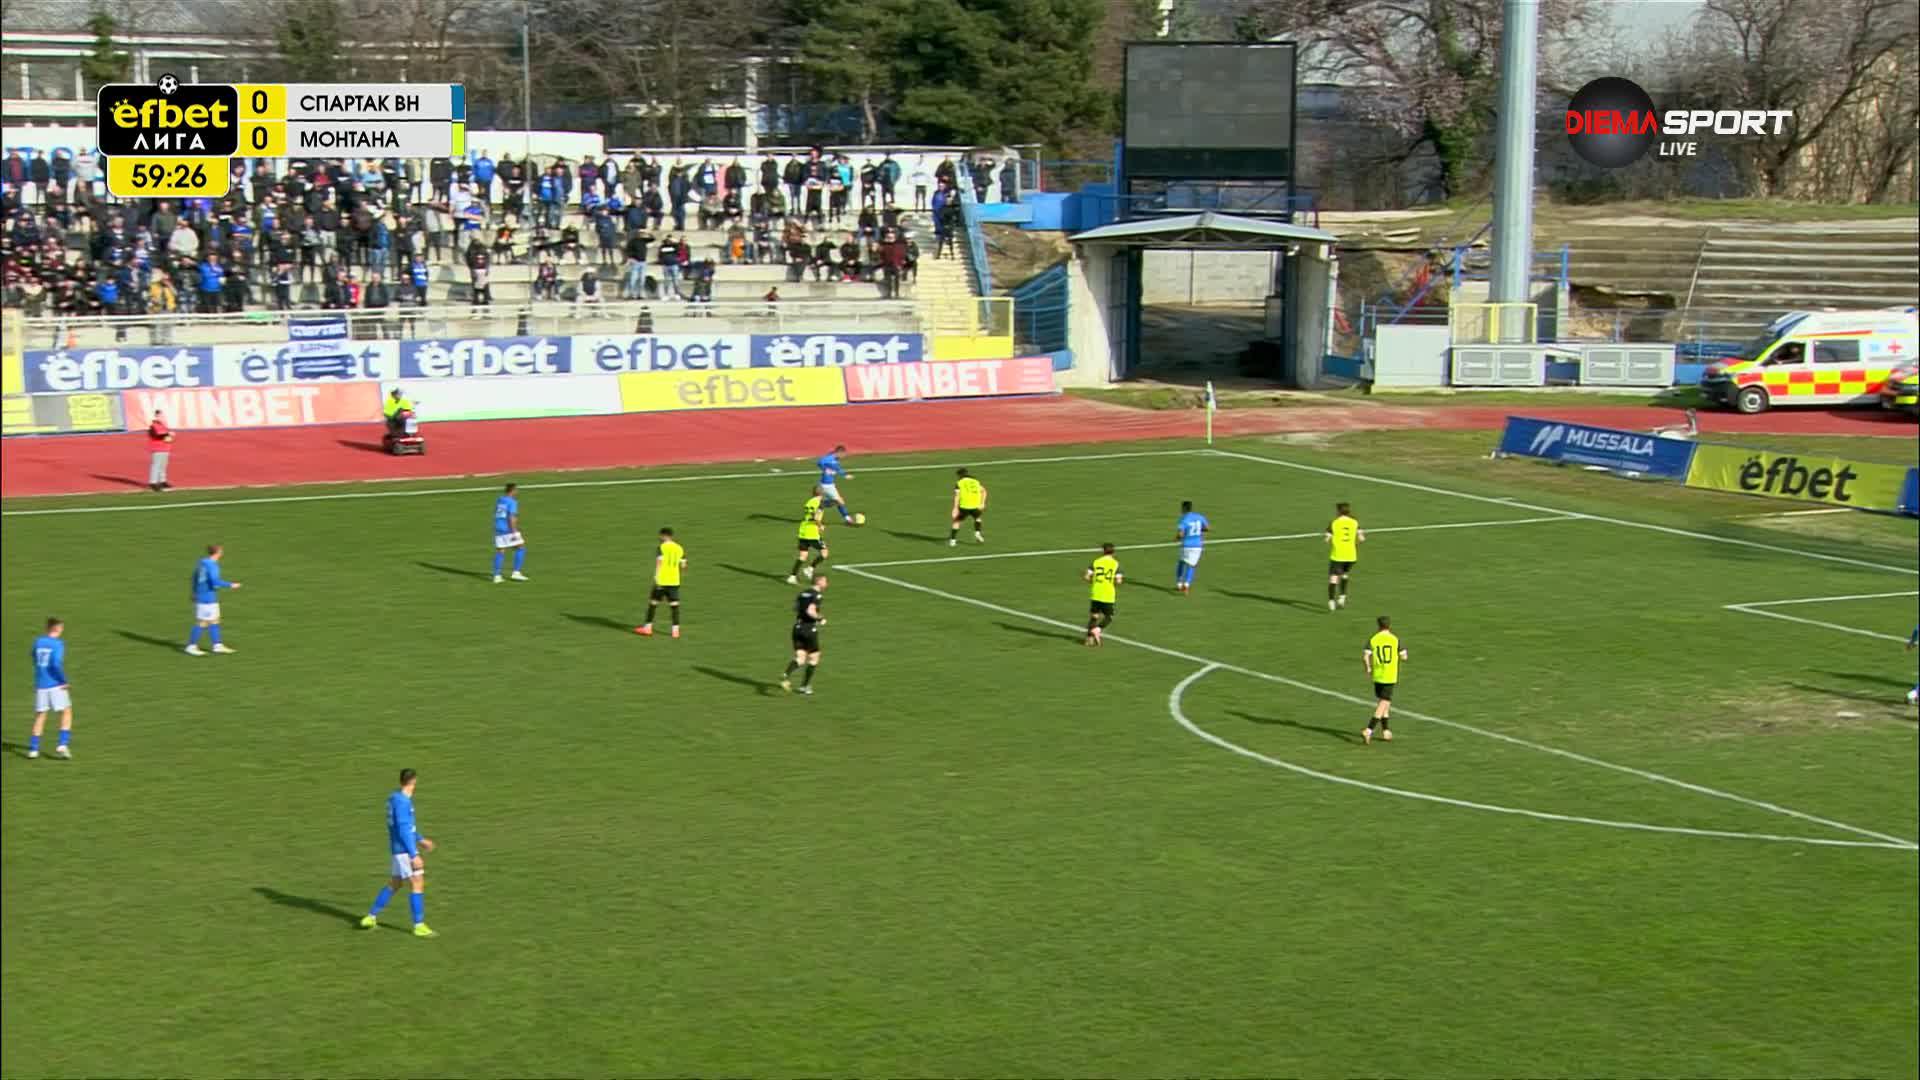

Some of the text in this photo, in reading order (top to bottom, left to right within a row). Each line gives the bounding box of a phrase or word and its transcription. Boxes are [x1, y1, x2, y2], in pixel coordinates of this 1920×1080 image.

[240, 344, 383, 382] efet
[417, 336, 559, 376] efbet
[593, 337, 733, 371] efbet
[767, 335, 909, 367] efbet
[41, 348, 200, 391] efbet
[857, 360, 1004, 399] WINBET
[139, 388, 321, 428] WINBET
[677, 374, 797, 406] efbet
[1565, 429, 1655, 457] MUSSALA
[1737, 454, 1858, 502] efbet
[1095, 566, 1113, 583] 24
[1376, 645, 1393, 664] 10
